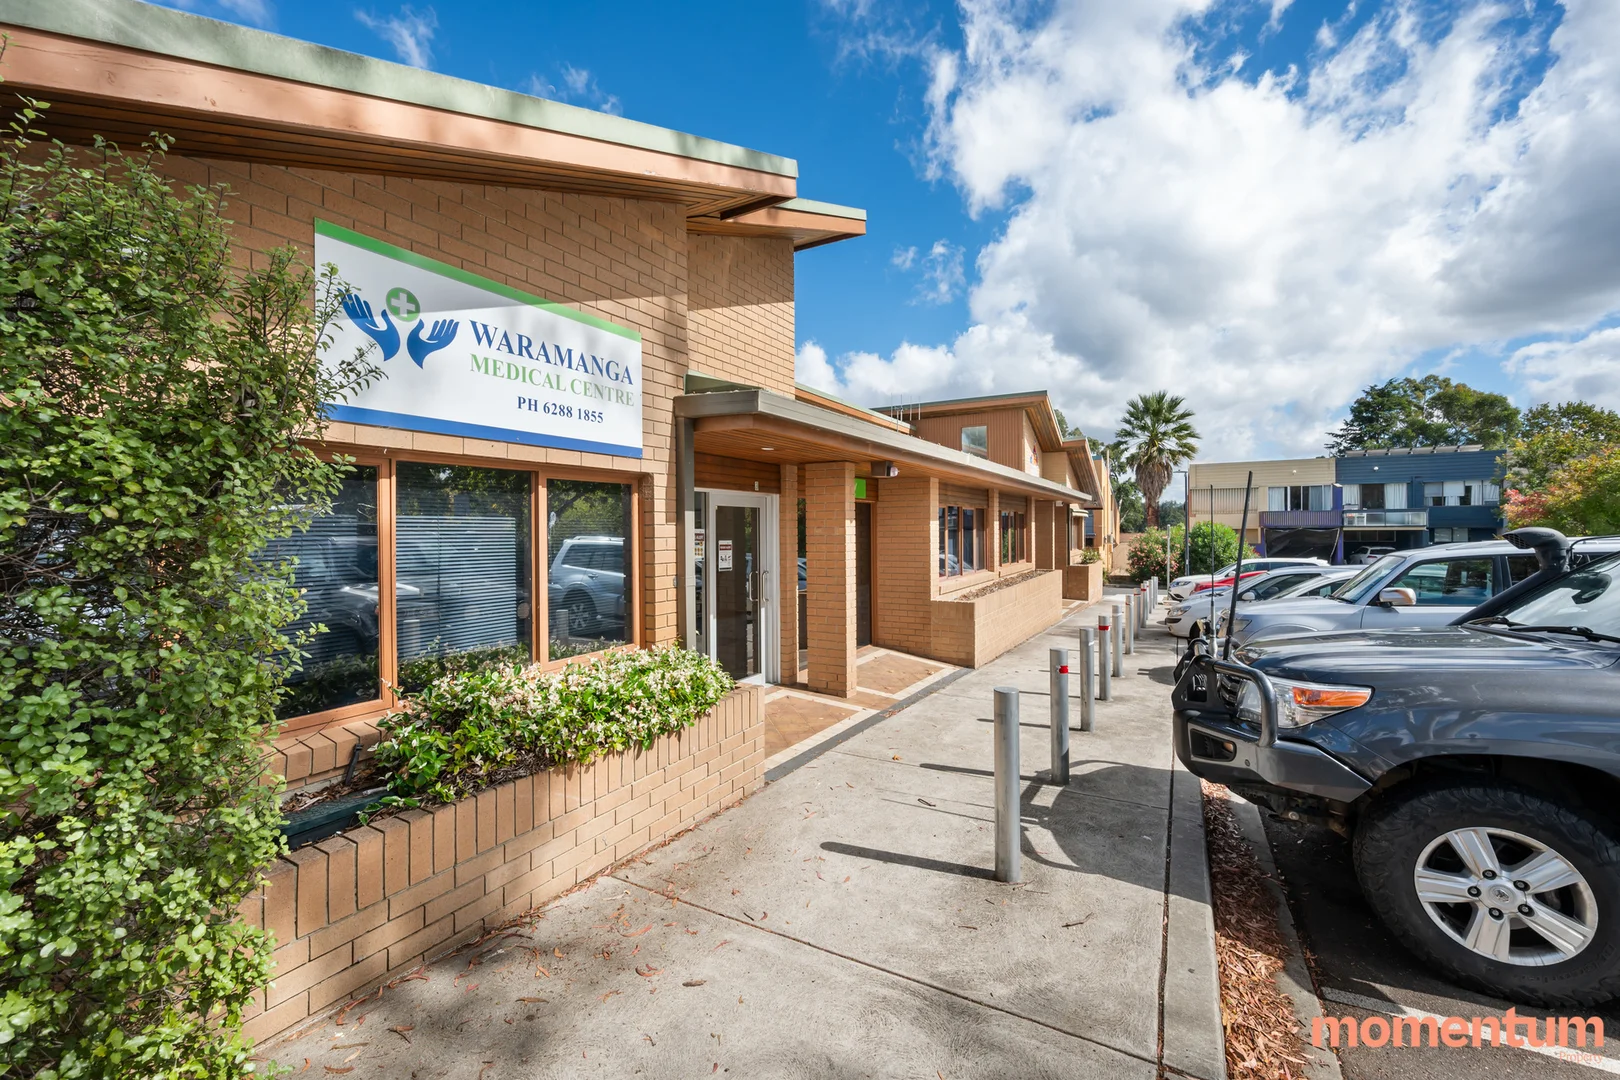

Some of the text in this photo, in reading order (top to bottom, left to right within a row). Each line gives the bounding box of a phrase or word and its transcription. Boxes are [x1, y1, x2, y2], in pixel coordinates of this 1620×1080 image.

[469, 320, 634, 386] WARAMANGA
[470, 353, 635, 407] MEDICAL CENTRE
[517, 396, 604, 424] PH 6288 1855
